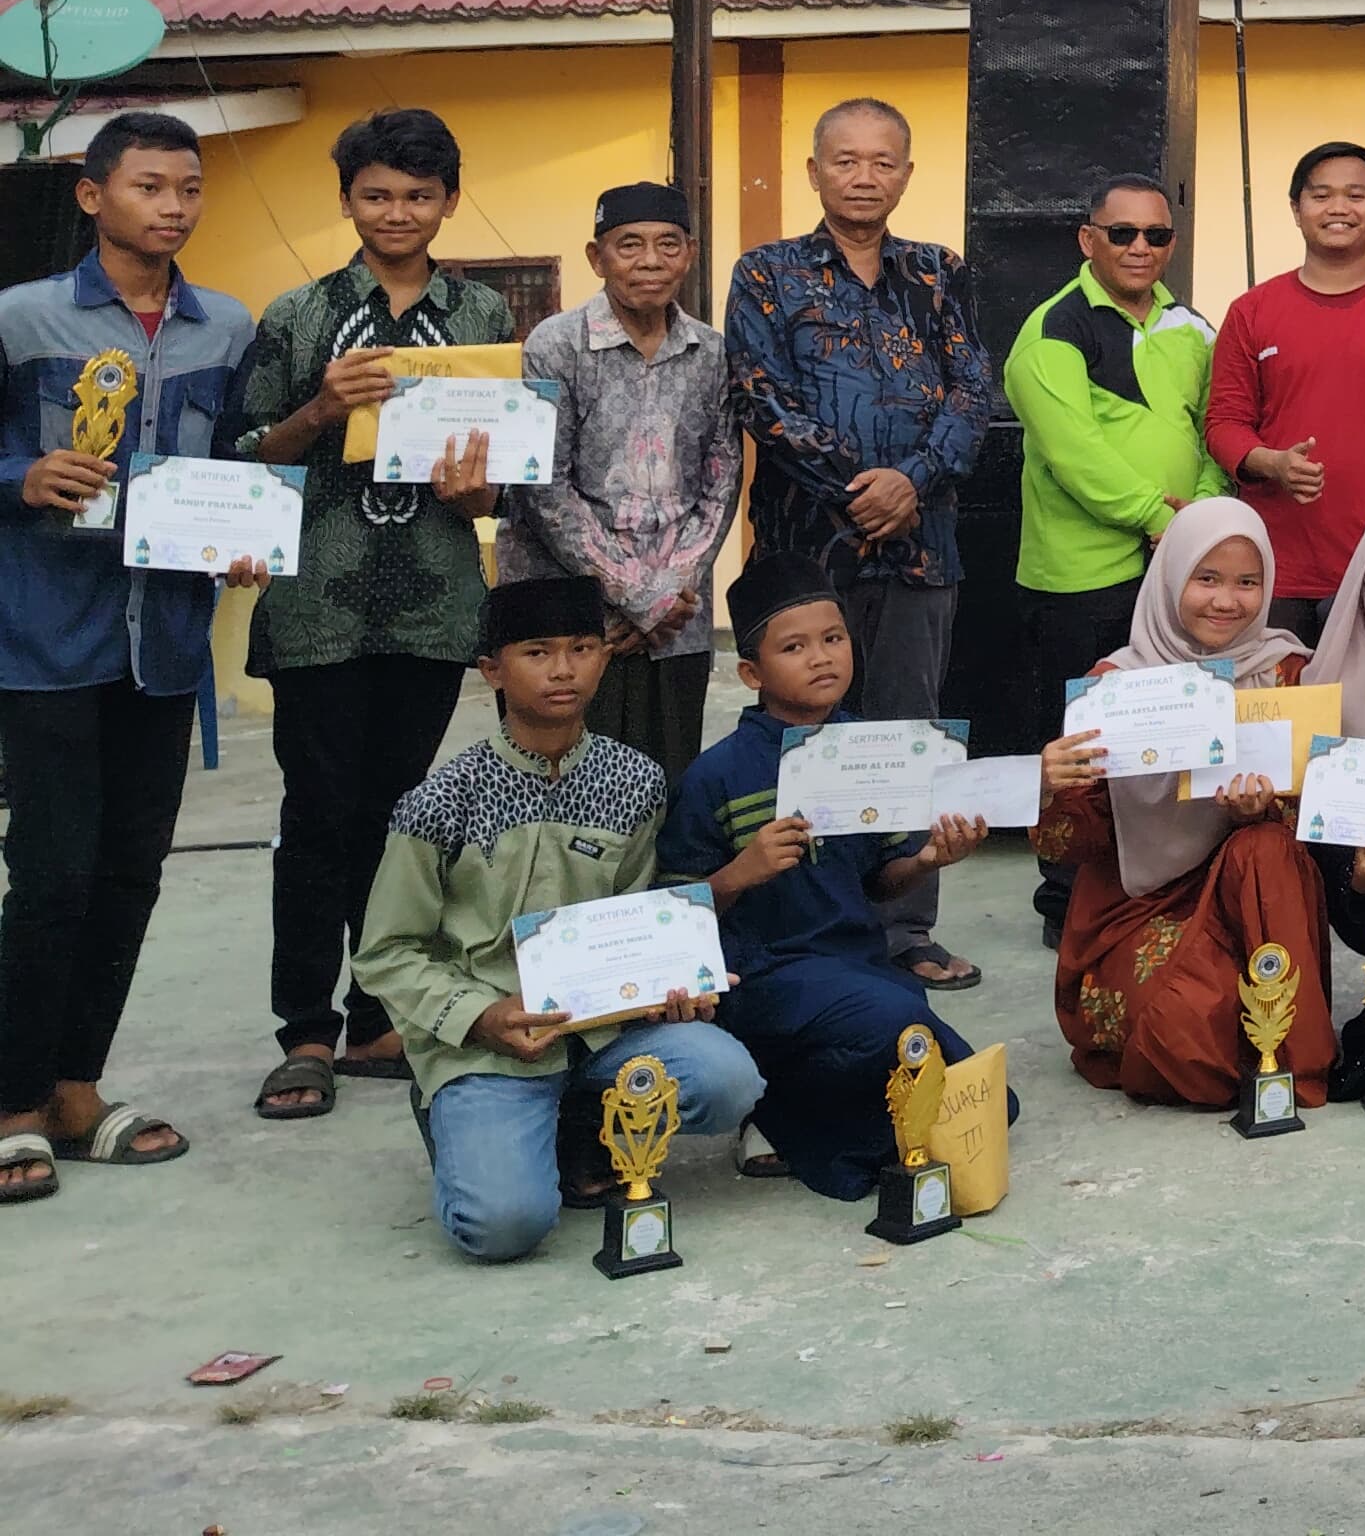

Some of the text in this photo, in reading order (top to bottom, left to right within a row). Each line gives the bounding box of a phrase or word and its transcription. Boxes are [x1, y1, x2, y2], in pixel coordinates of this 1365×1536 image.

[1236, 700, 1283, 722] UARA
[847, 732, 903, 745] SERTIFIKAT
[585, 905, 645, 923] SERTIFIKAT
[937, 1077, 991, 1126] JUARA
